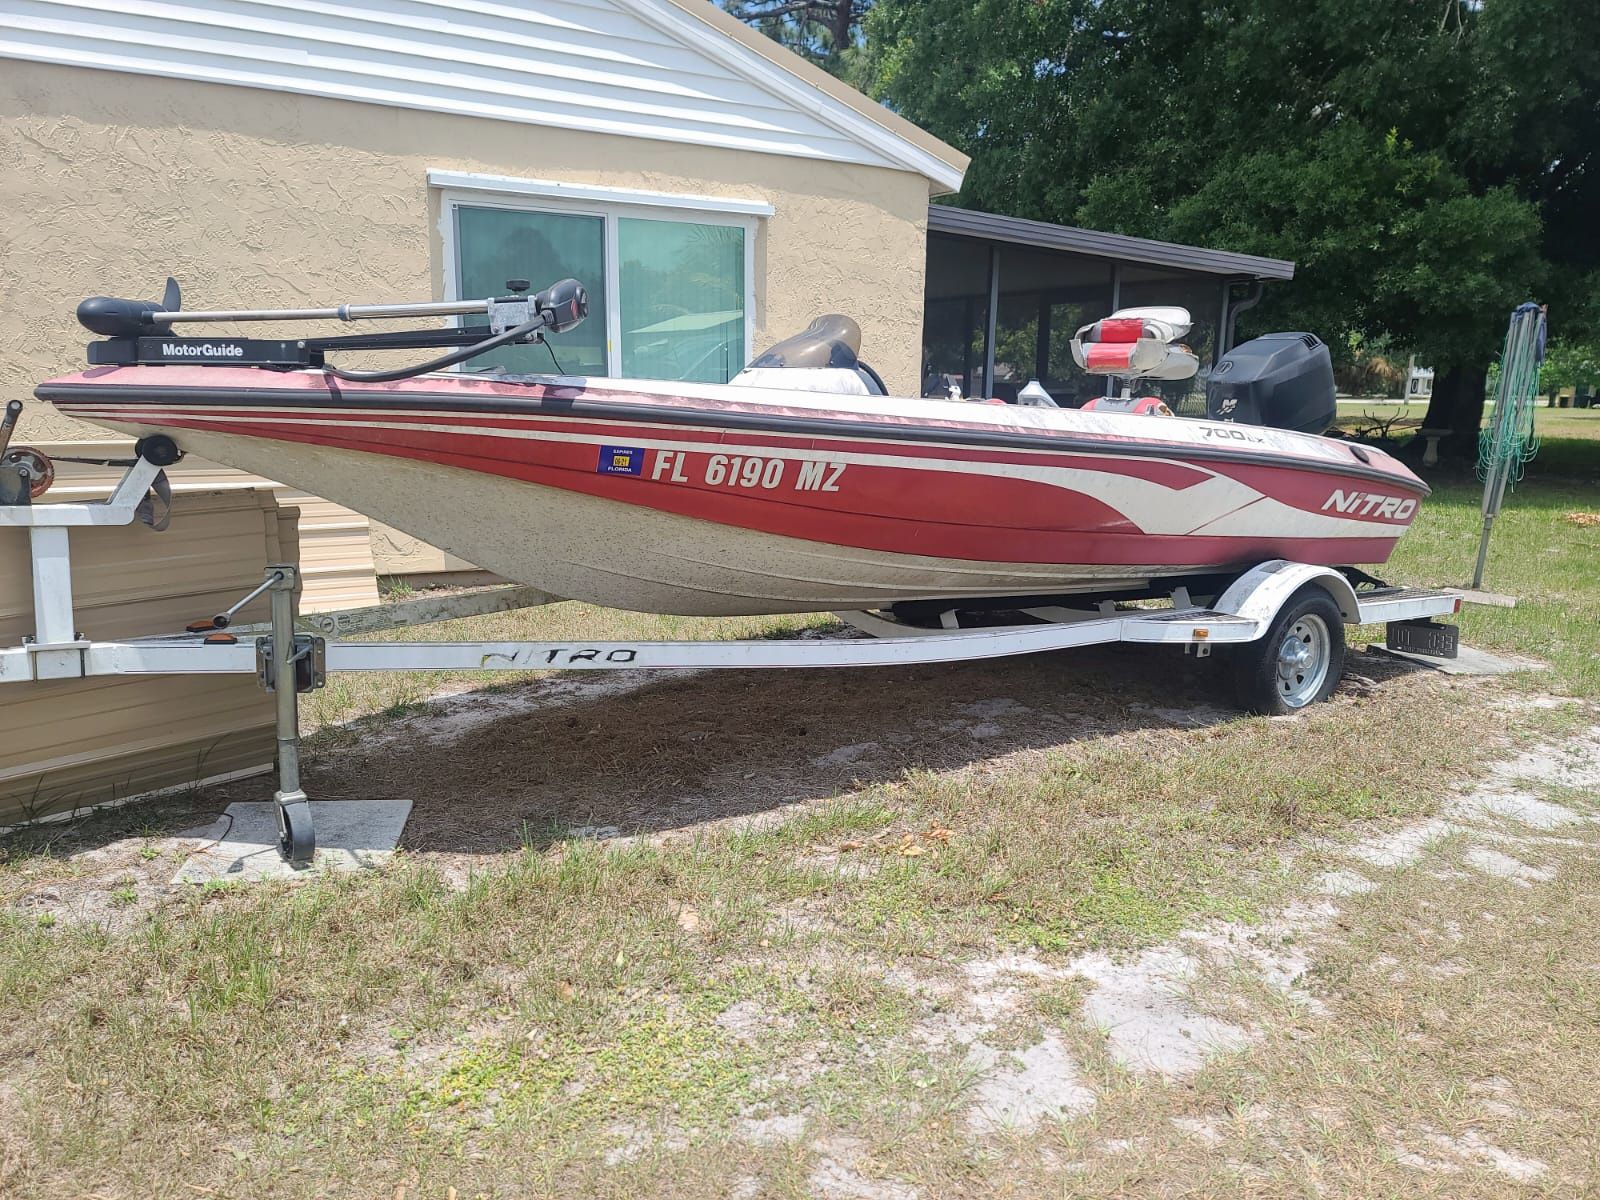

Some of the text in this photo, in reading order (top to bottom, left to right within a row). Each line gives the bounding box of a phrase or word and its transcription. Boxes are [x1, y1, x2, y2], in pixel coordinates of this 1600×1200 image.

[162, 343, 244, 357] MotorGuide
[651, 451, 847, 492] FL 6190 MZ
